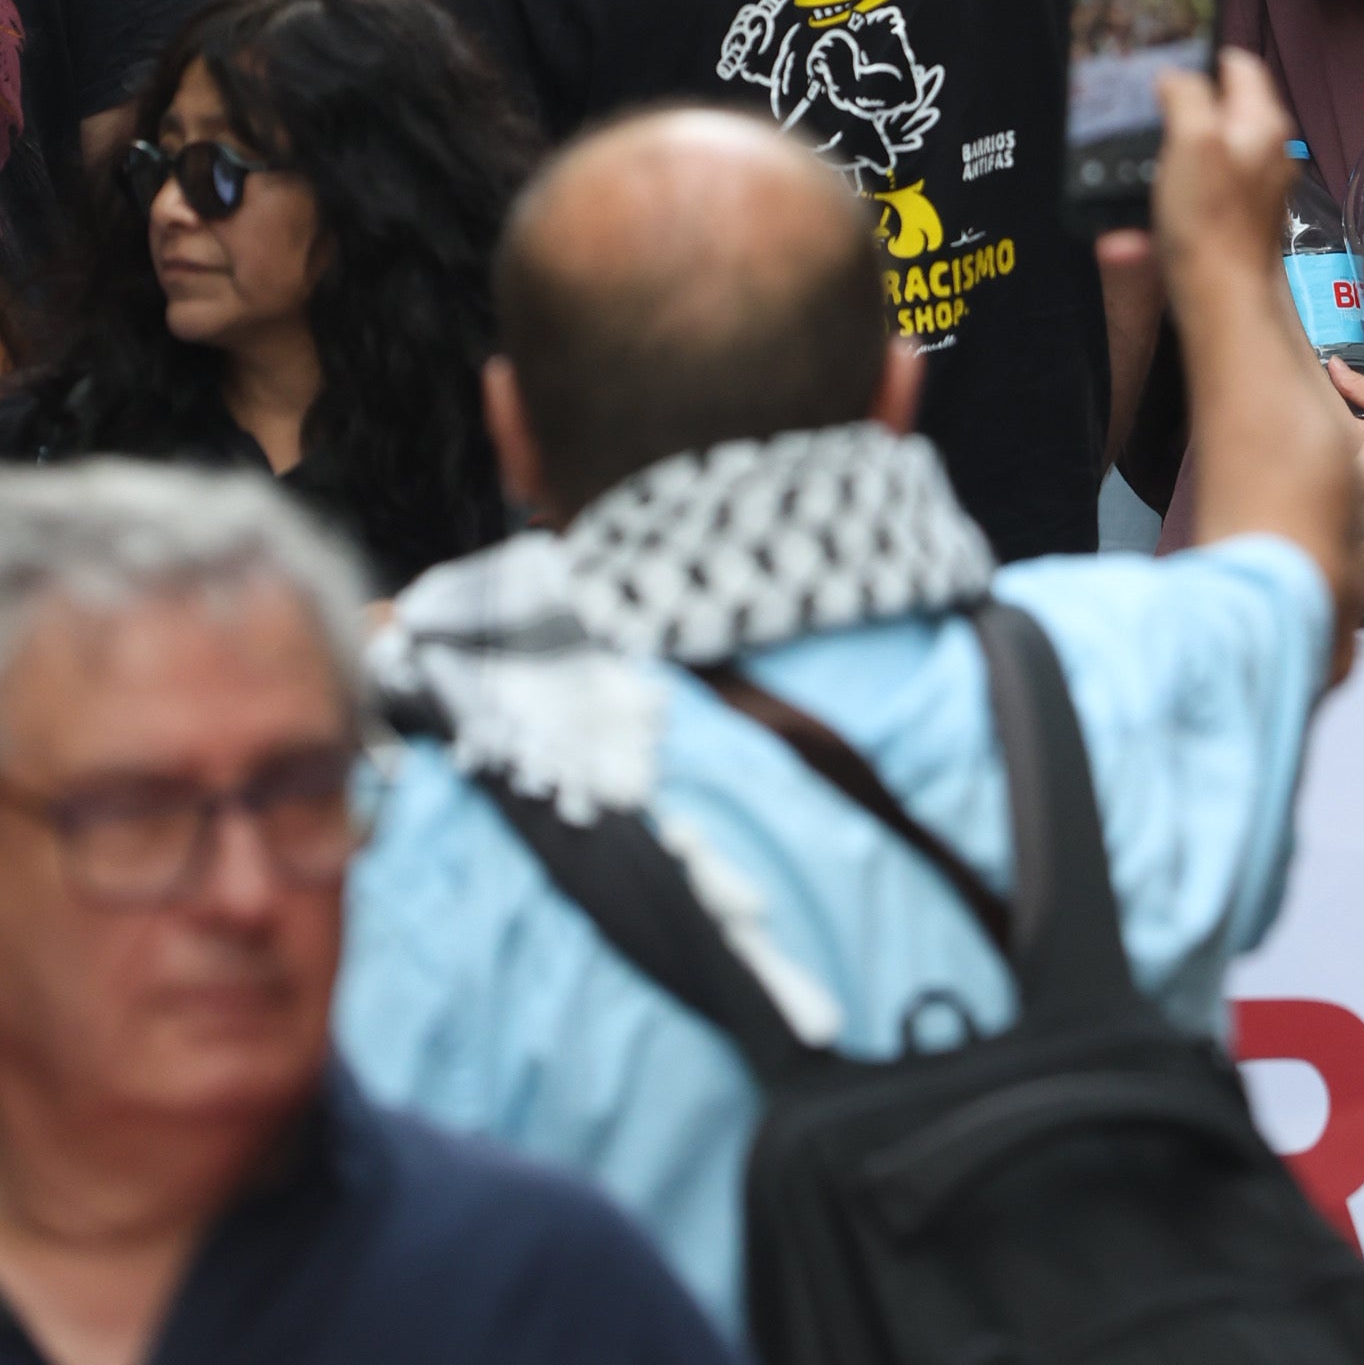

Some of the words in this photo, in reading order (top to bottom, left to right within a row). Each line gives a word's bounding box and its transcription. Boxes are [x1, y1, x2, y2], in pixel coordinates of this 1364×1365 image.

[961, 129, 1017, 164] BARRIOS
[962, 149, 1015, 182] ANTIFAS
[882, 237, 1016, 306] RACISMO
